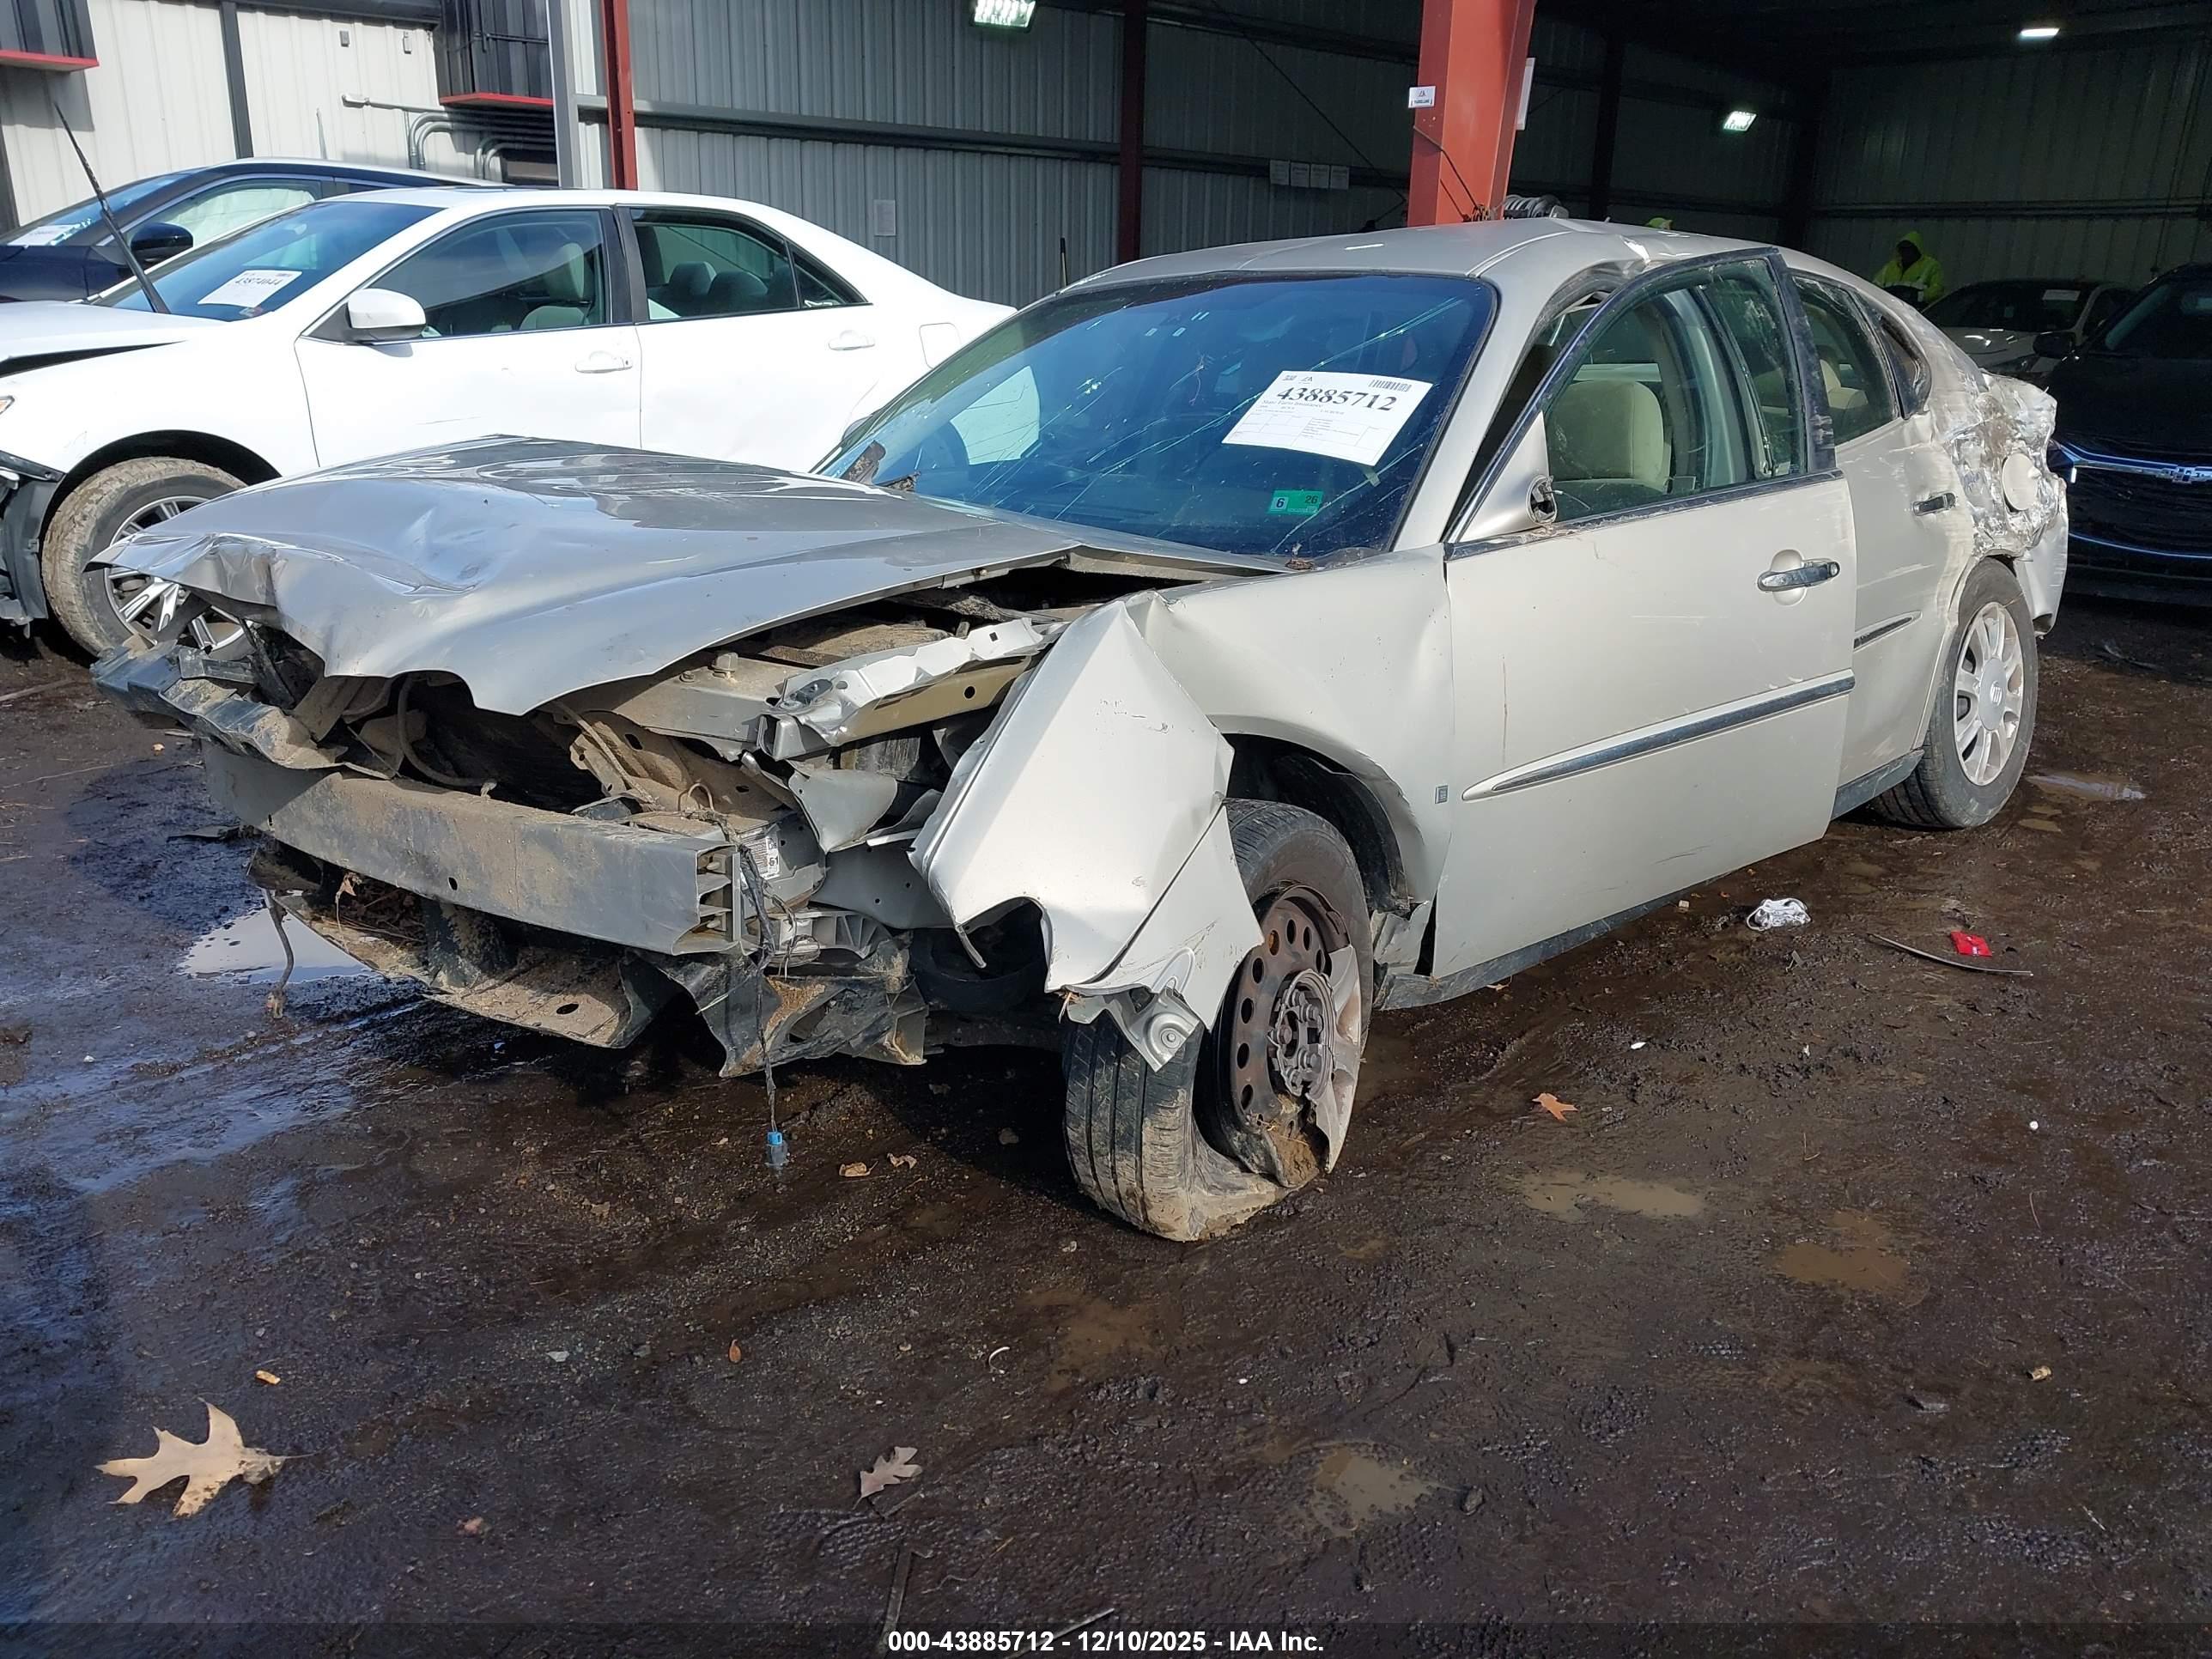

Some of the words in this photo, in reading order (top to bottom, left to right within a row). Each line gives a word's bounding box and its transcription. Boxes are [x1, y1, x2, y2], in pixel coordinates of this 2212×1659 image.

[1277, 386, 1398, 411] 43885712
[1276, 497, 1285, 508] 6
[1304, 495, 1319, 504] 26
